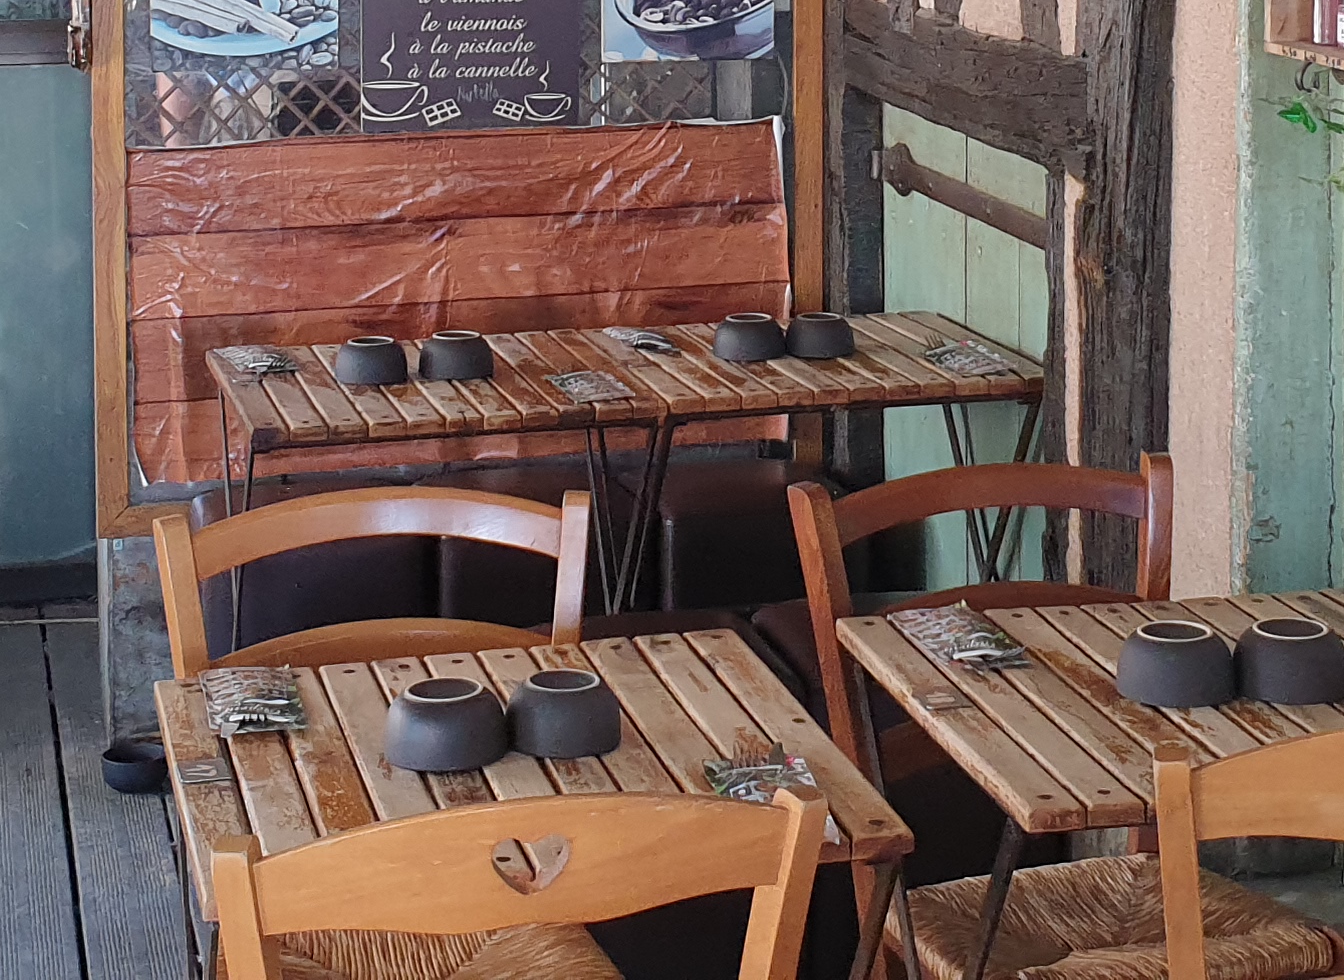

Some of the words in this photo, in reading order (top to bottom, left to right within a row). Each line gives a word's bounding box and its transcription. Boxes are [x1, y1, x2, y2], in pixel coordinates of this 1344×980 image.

[420, 11, 441, 32] le
[447, 15, 528, 31] viennois
[409, 38, 424, 54] à
[430, 34, 451, 54] la
[455, 32, 536, 60] pistache
[407, 63, 422, 79] à
[429, 58, 449, 78] la
[455, 57, 539, 78] cannelle
